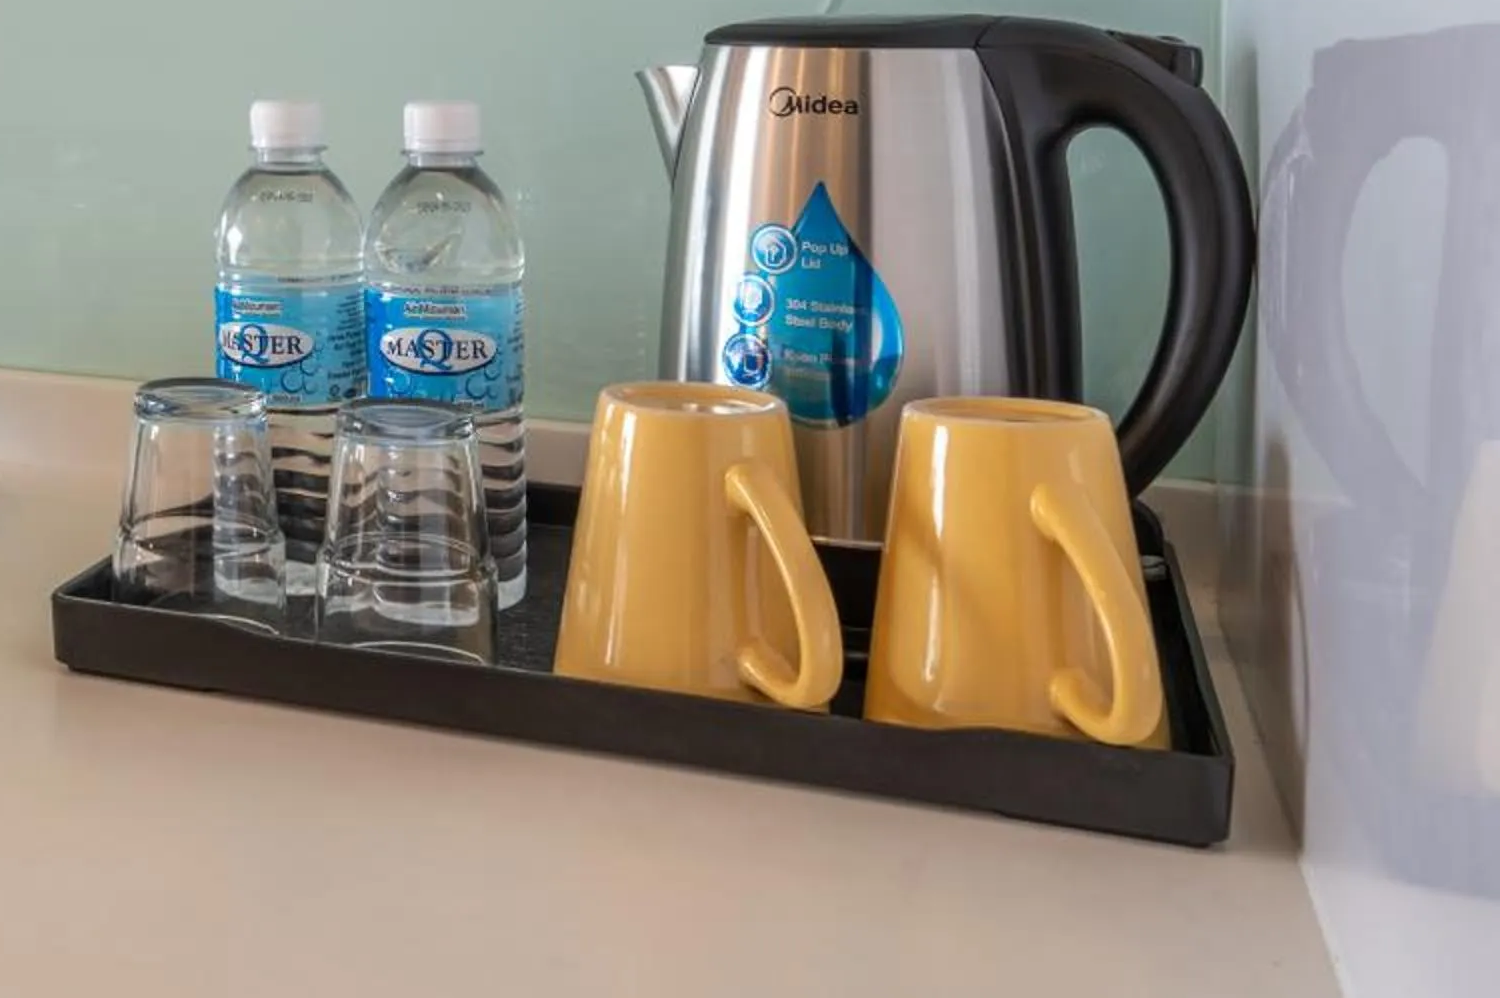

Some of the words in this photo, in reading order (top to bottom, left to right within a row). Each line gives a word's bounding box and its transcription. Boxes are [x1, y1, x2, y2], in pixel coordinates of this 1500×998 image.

[769, 86, 859, 117] Midea
[802, 241, 826, 255] Pop
[829, 242, 849, 257] Up
[801, 258, 821, 269] Lid
[785, 313, 814, 326] Steel
[818, 317, 852, 332] Body
[222, 330, 304, 355] MASTER
[387, 338, 488, 360] MASTER
